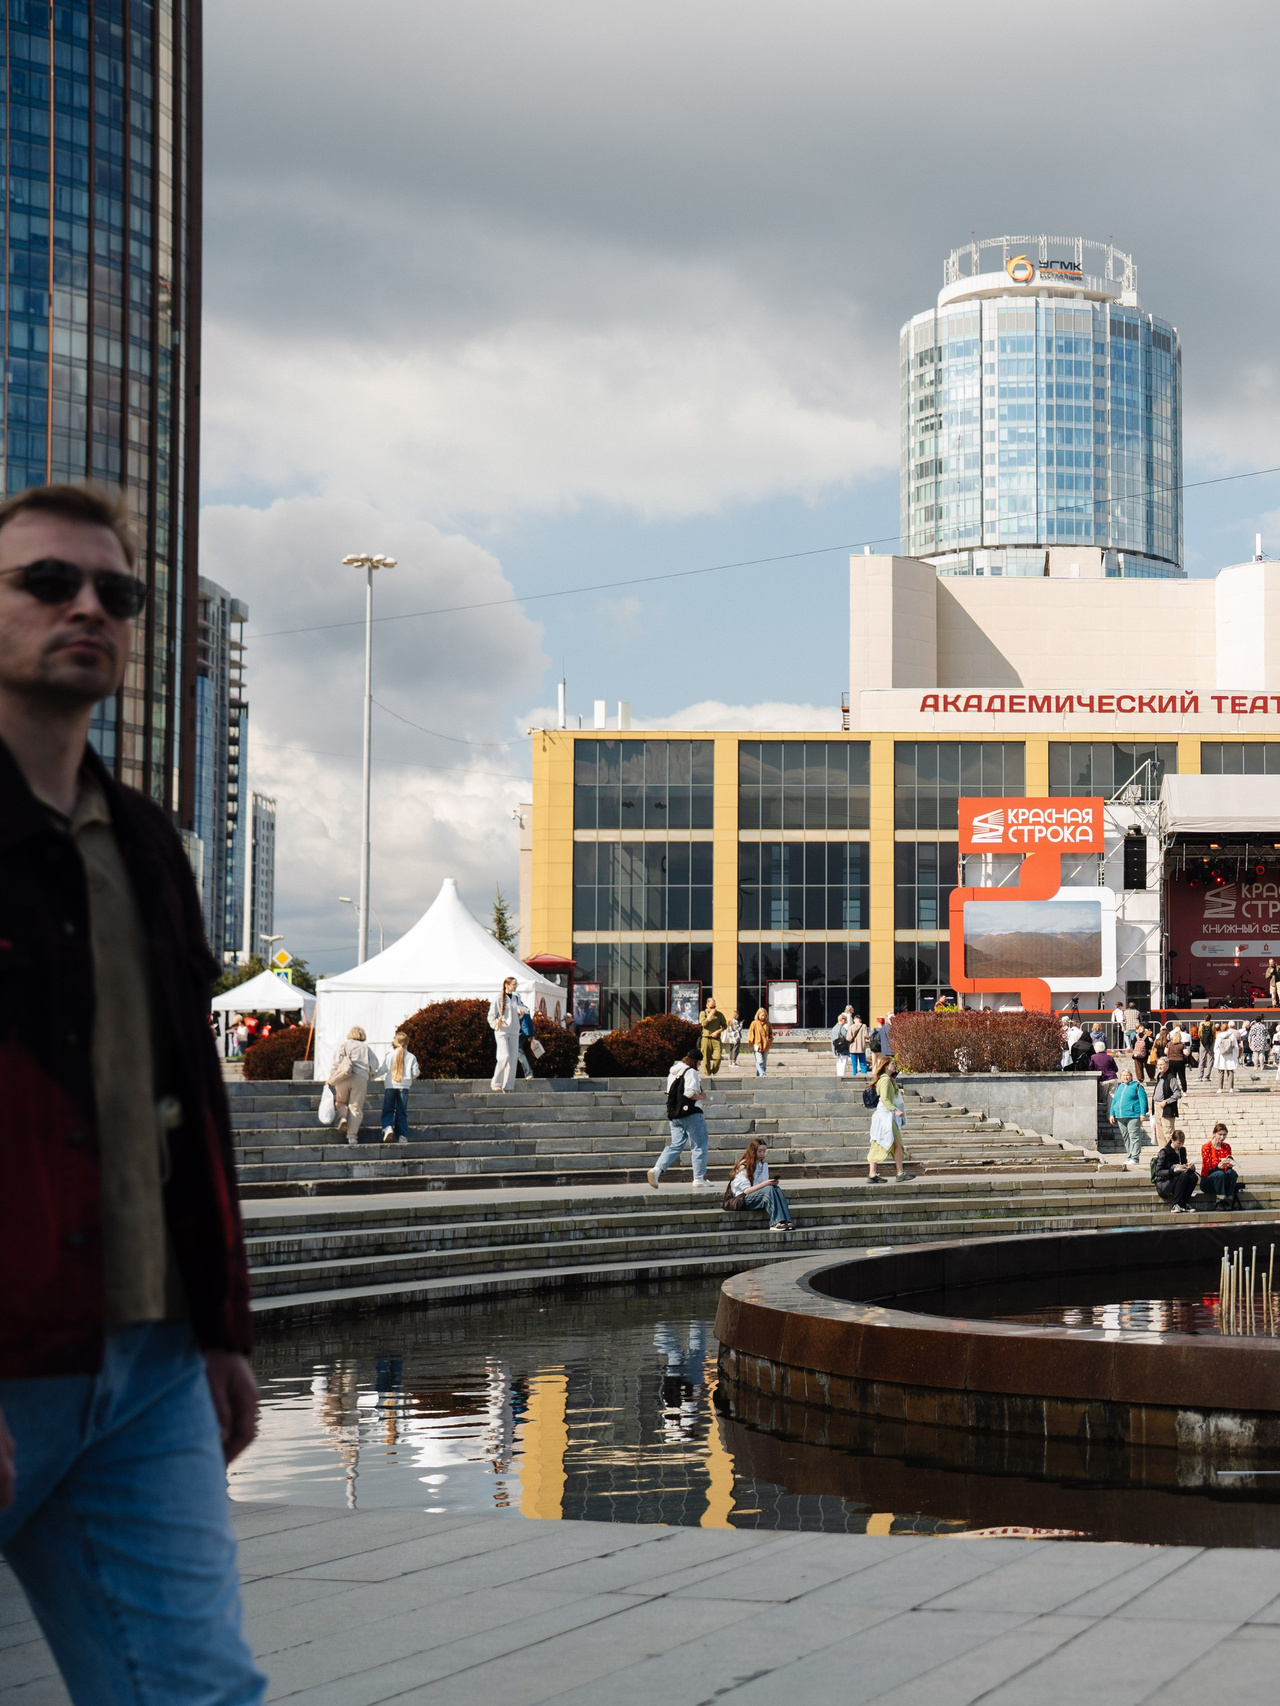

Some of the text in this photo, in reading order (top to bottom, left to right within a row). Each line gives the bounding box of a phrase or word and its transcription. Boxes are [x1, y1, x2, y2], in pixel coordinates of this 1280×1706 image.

[1039, 260, 1082, 271] УГМК
[920, 690, 1199, 713] АКАДЕМИЧЕСКИЙ
[1008, 808, 1093, 824] КРАСНАЯ
[1008, 825, 1093, 843] СТРОКА
[1202, 923, 1260, 934] КНИЖНЫЙ
